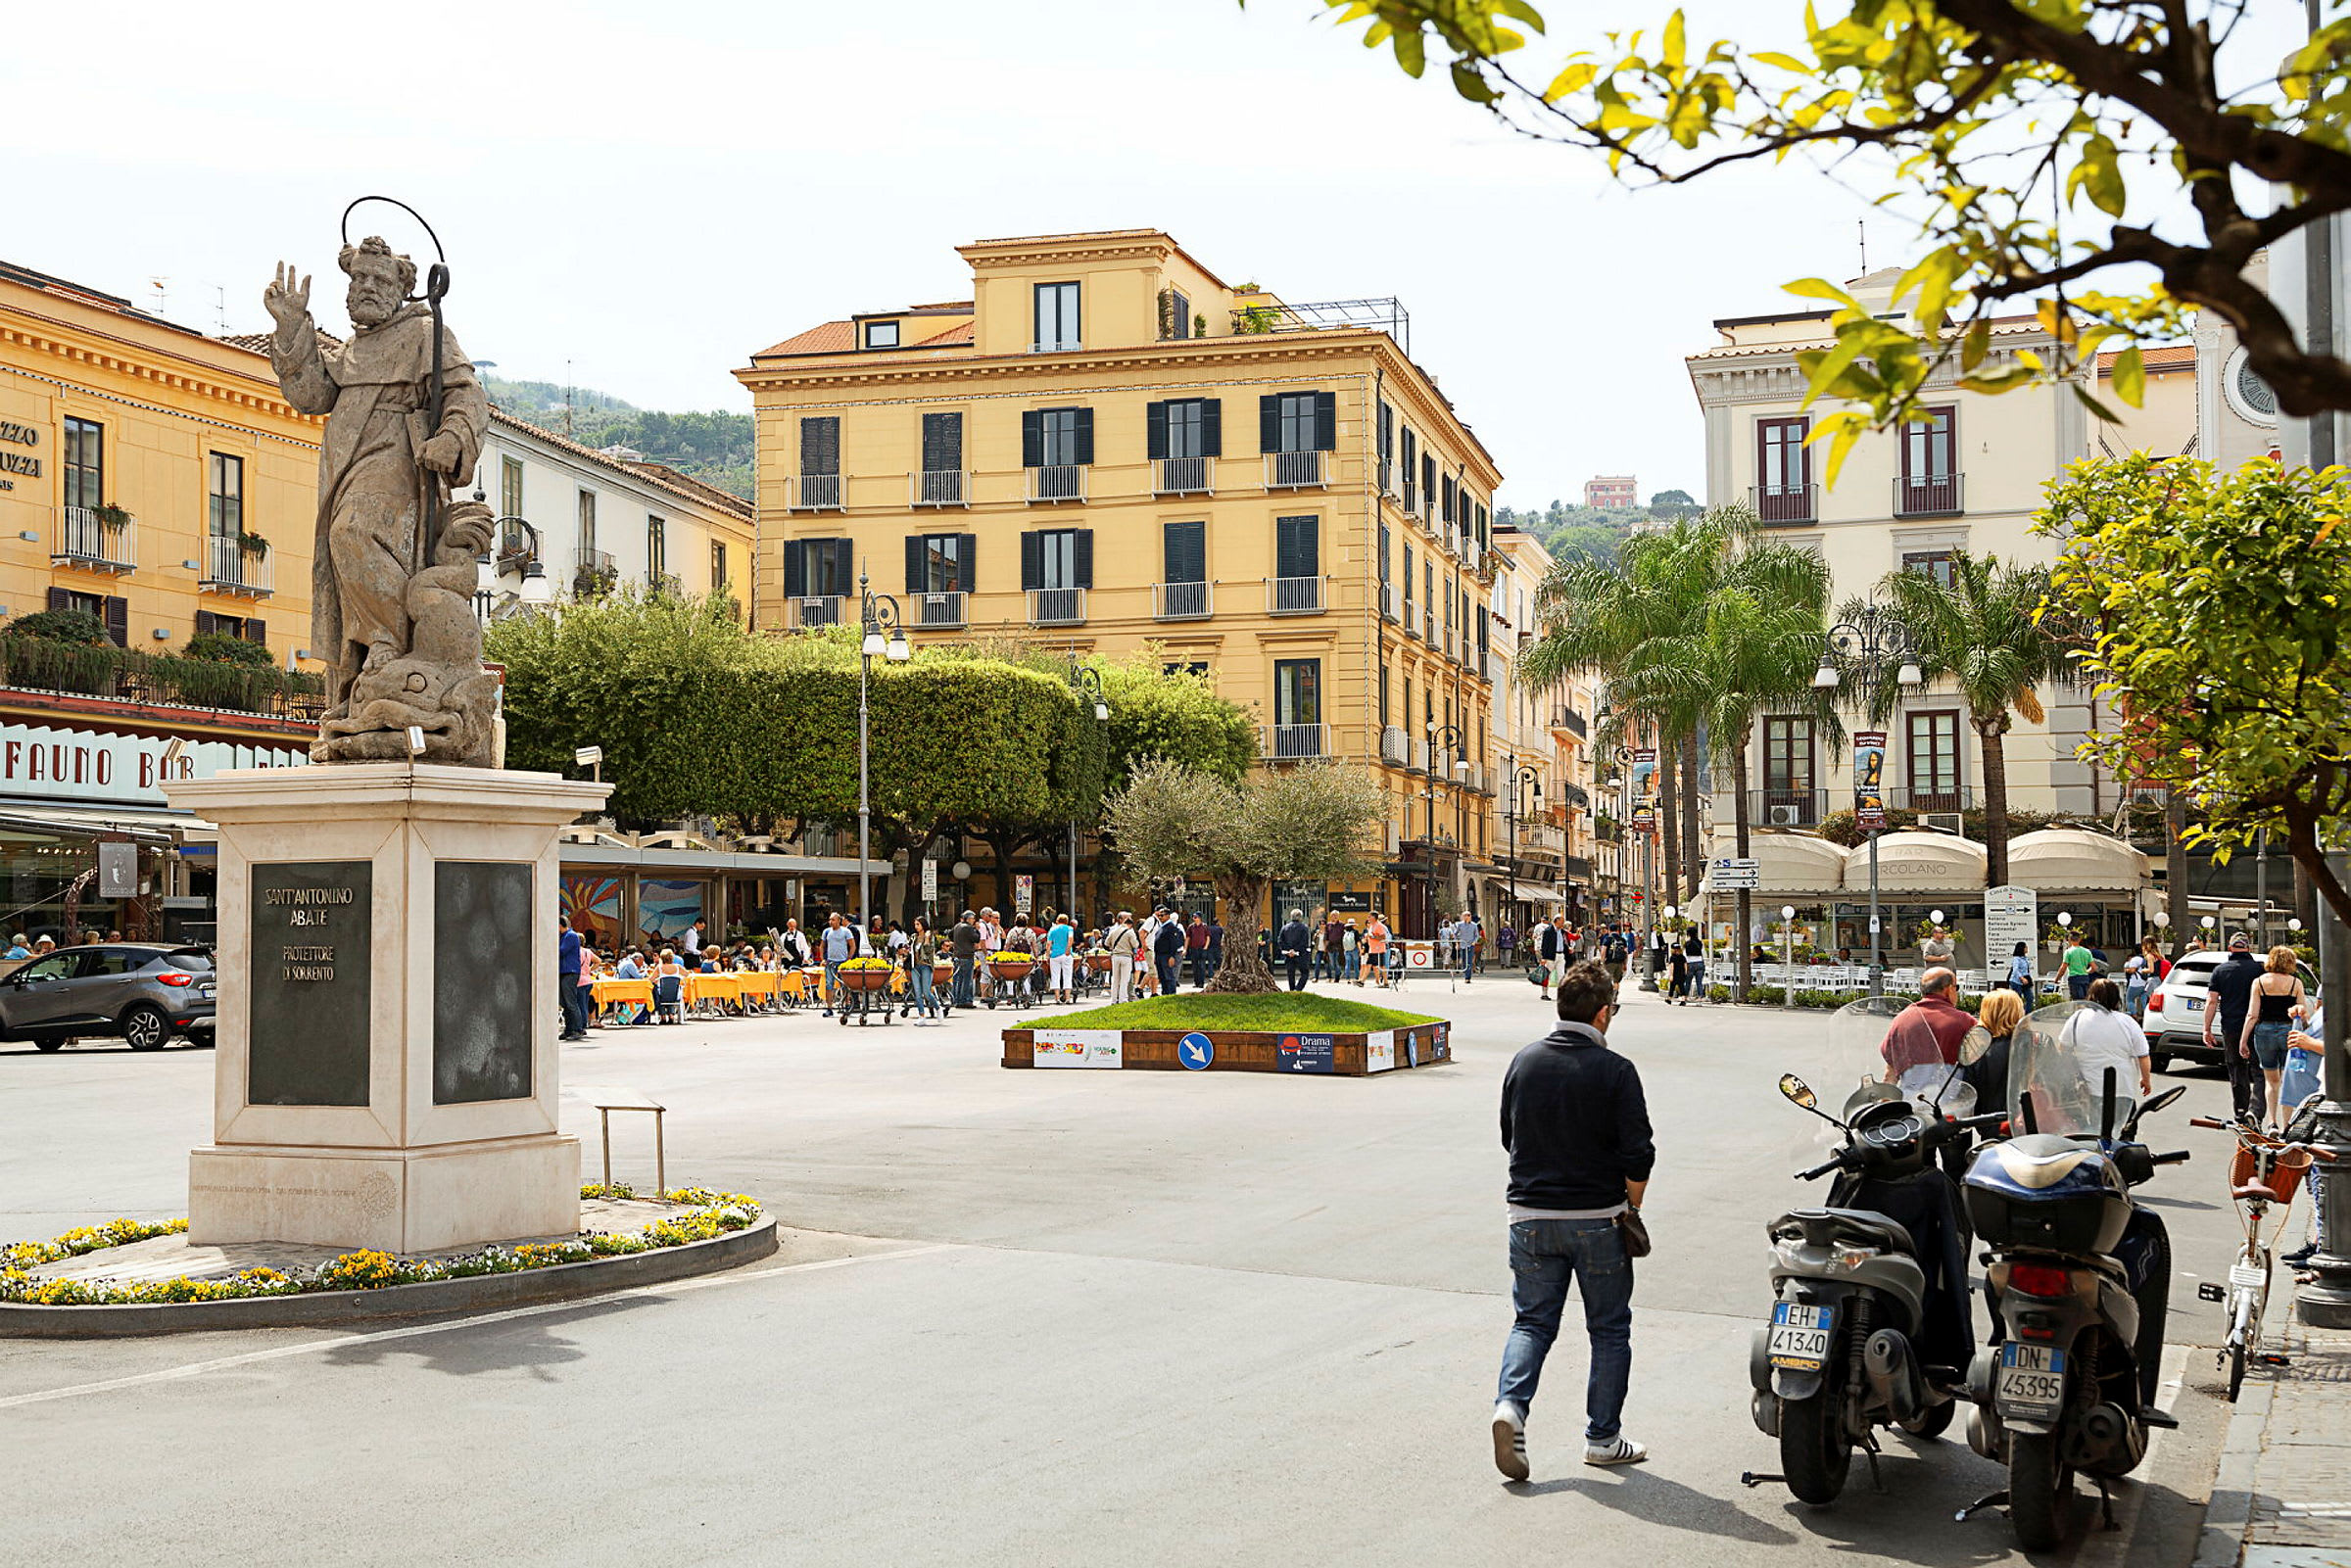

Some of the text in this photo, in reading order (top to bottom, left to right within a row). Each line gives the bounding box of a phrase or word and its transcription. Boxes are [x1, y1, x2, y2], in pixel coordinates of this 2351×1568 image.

[5, 740, 112, 785] FAUNO
[1880, 864, 1946, 876] RCOLANO
[290, 909, 328, 926] ABATE
[283, 946, 334, 961] PROTETTORE
[284, 966, 334, 981] DI SORRENTO
[1301, 1035, 1330, 1046] Drama
[1789, 1306, 1811, 1326] EH
[1773, 1330, 1827, 1354] 41340
[2018, 1346, 2041, 1368] DN
[2002, 1373, 2061, 1399] 45395
